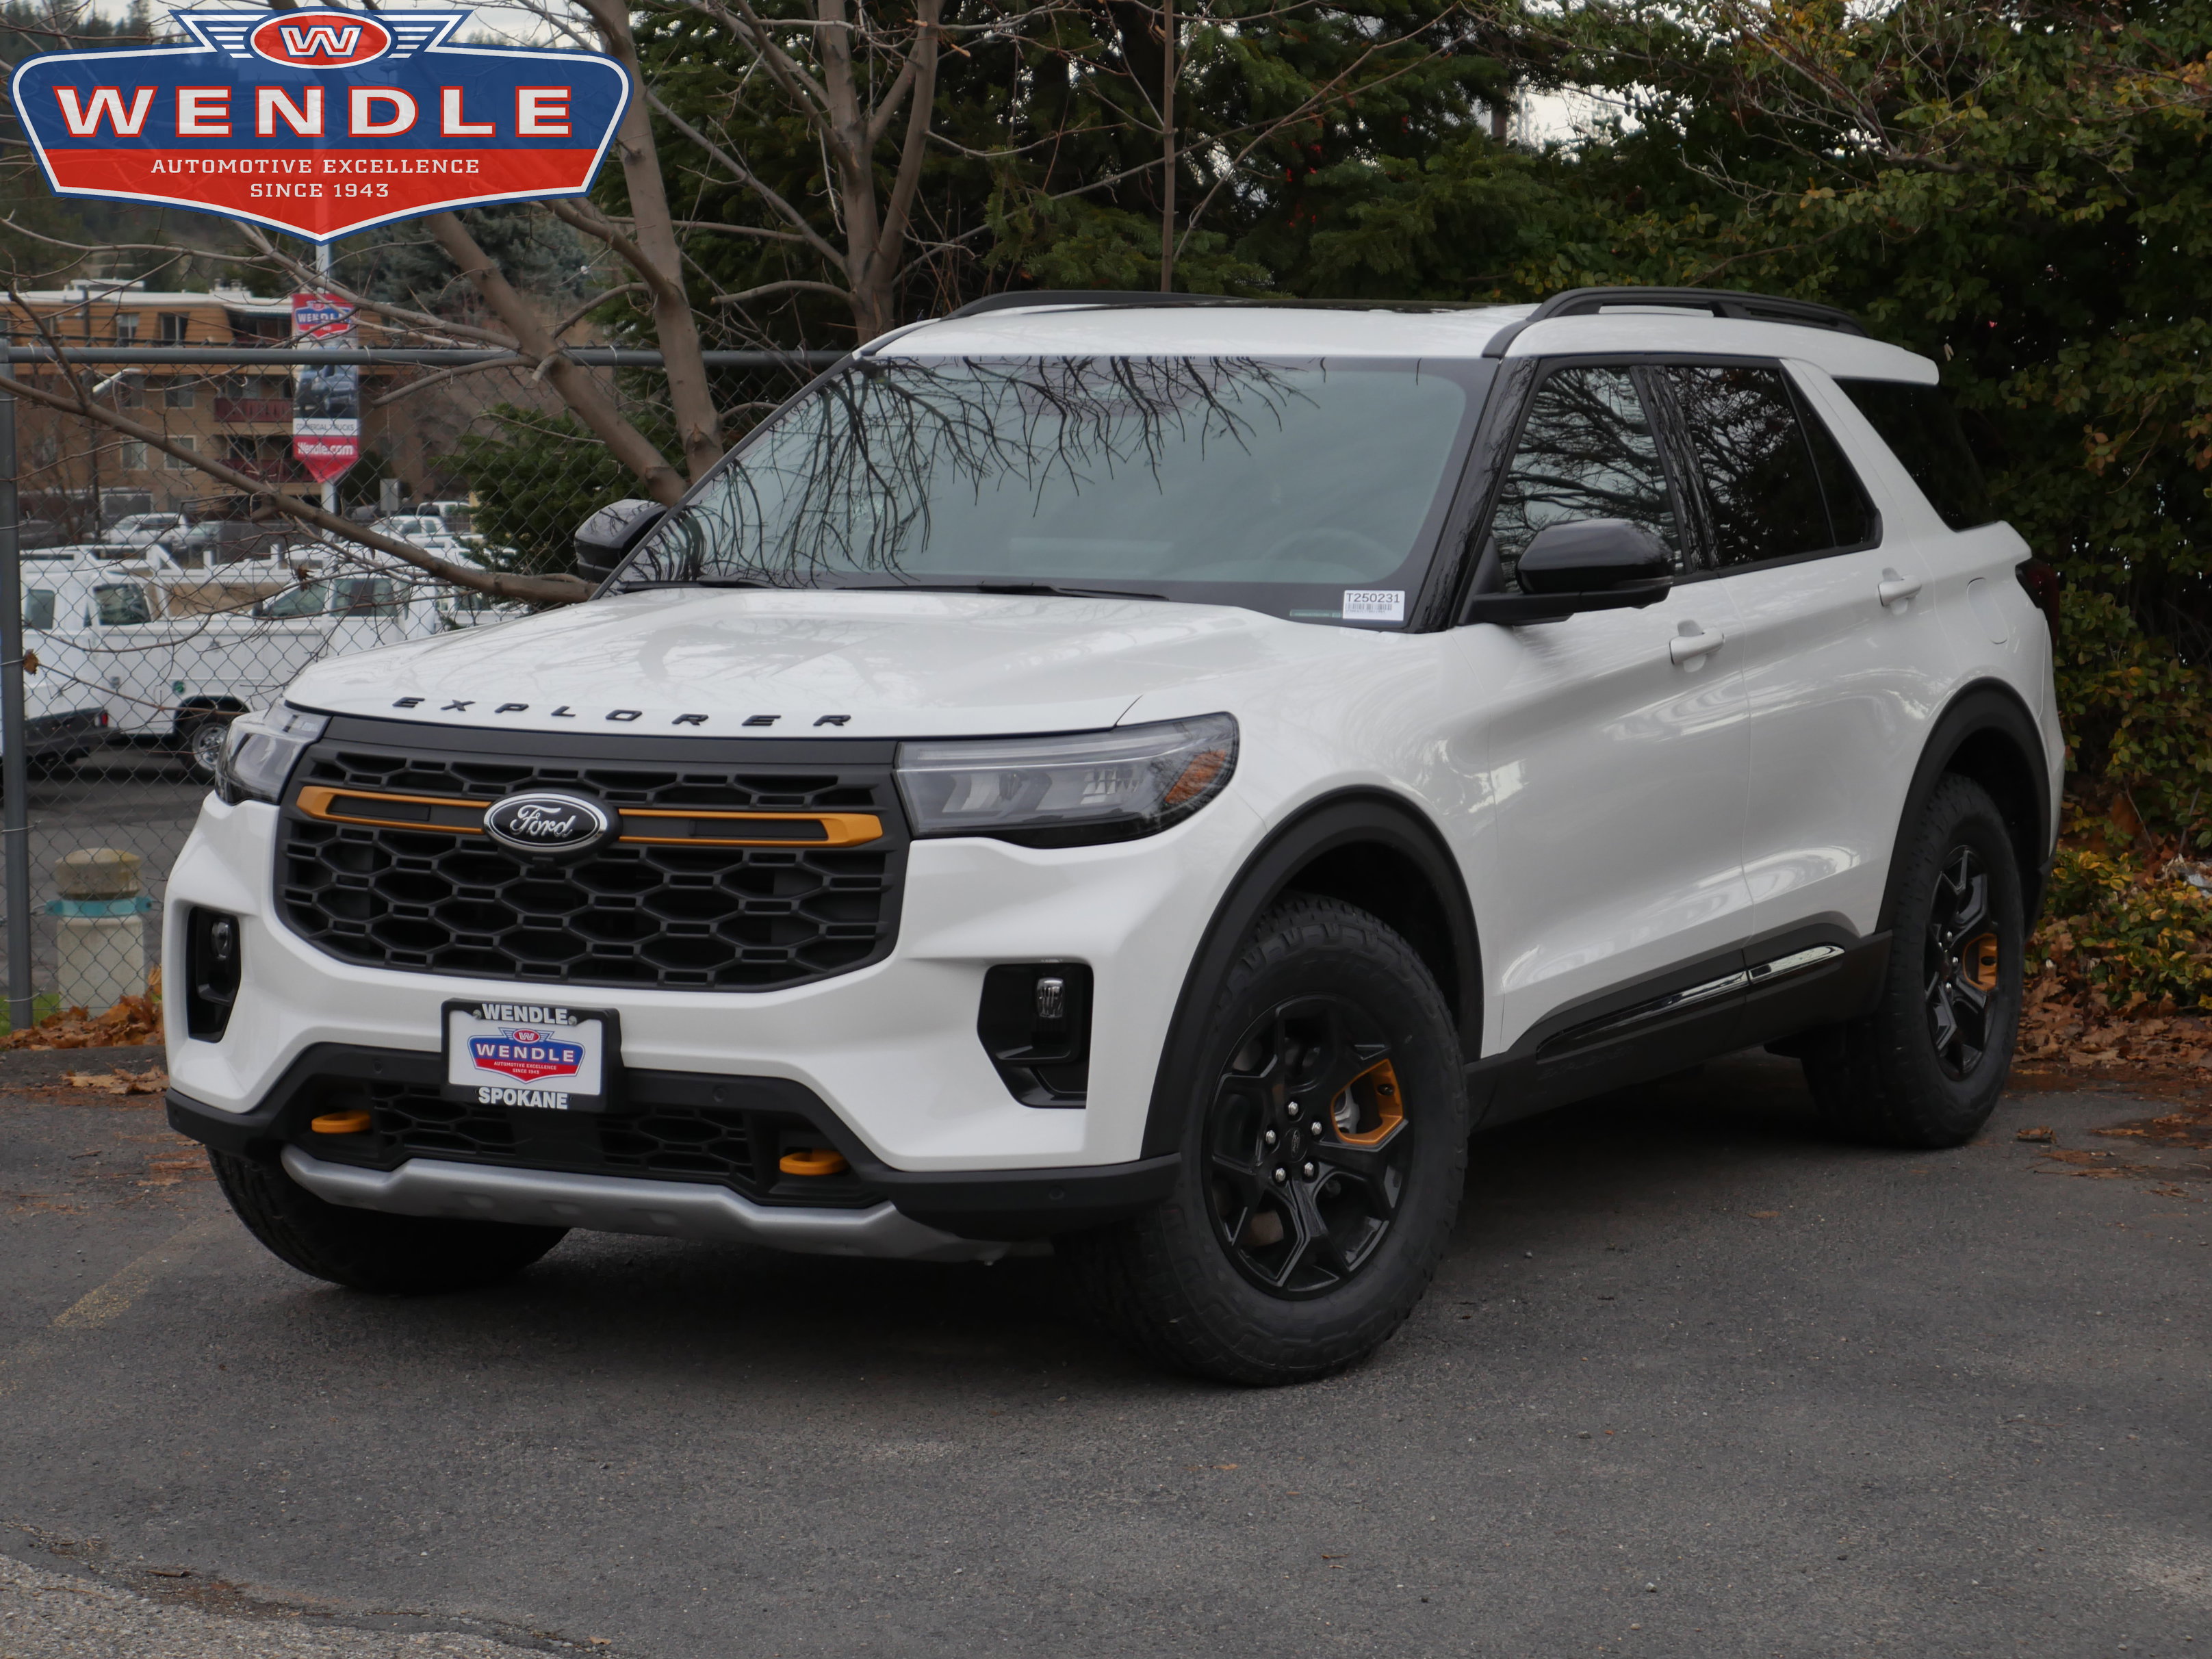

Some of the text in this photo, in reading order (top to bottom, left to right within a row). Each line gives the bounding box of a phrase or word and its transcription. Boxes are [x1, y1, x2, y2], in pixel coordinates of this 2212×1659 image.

[298, 313, 350, 324] WENDL
[297, 441, 354, 455] Wendle.com
[1346, 593, 1400, 603] T250231
[392, 696, 851, 727] EXPLORER
[510, 804, 574, 838] Ford
[482, 1003, 568, 1025] WENDLE
[476, 1043, 574, 1062] WENDLE
[478, 1086, 568, 1109] SPOKANE
